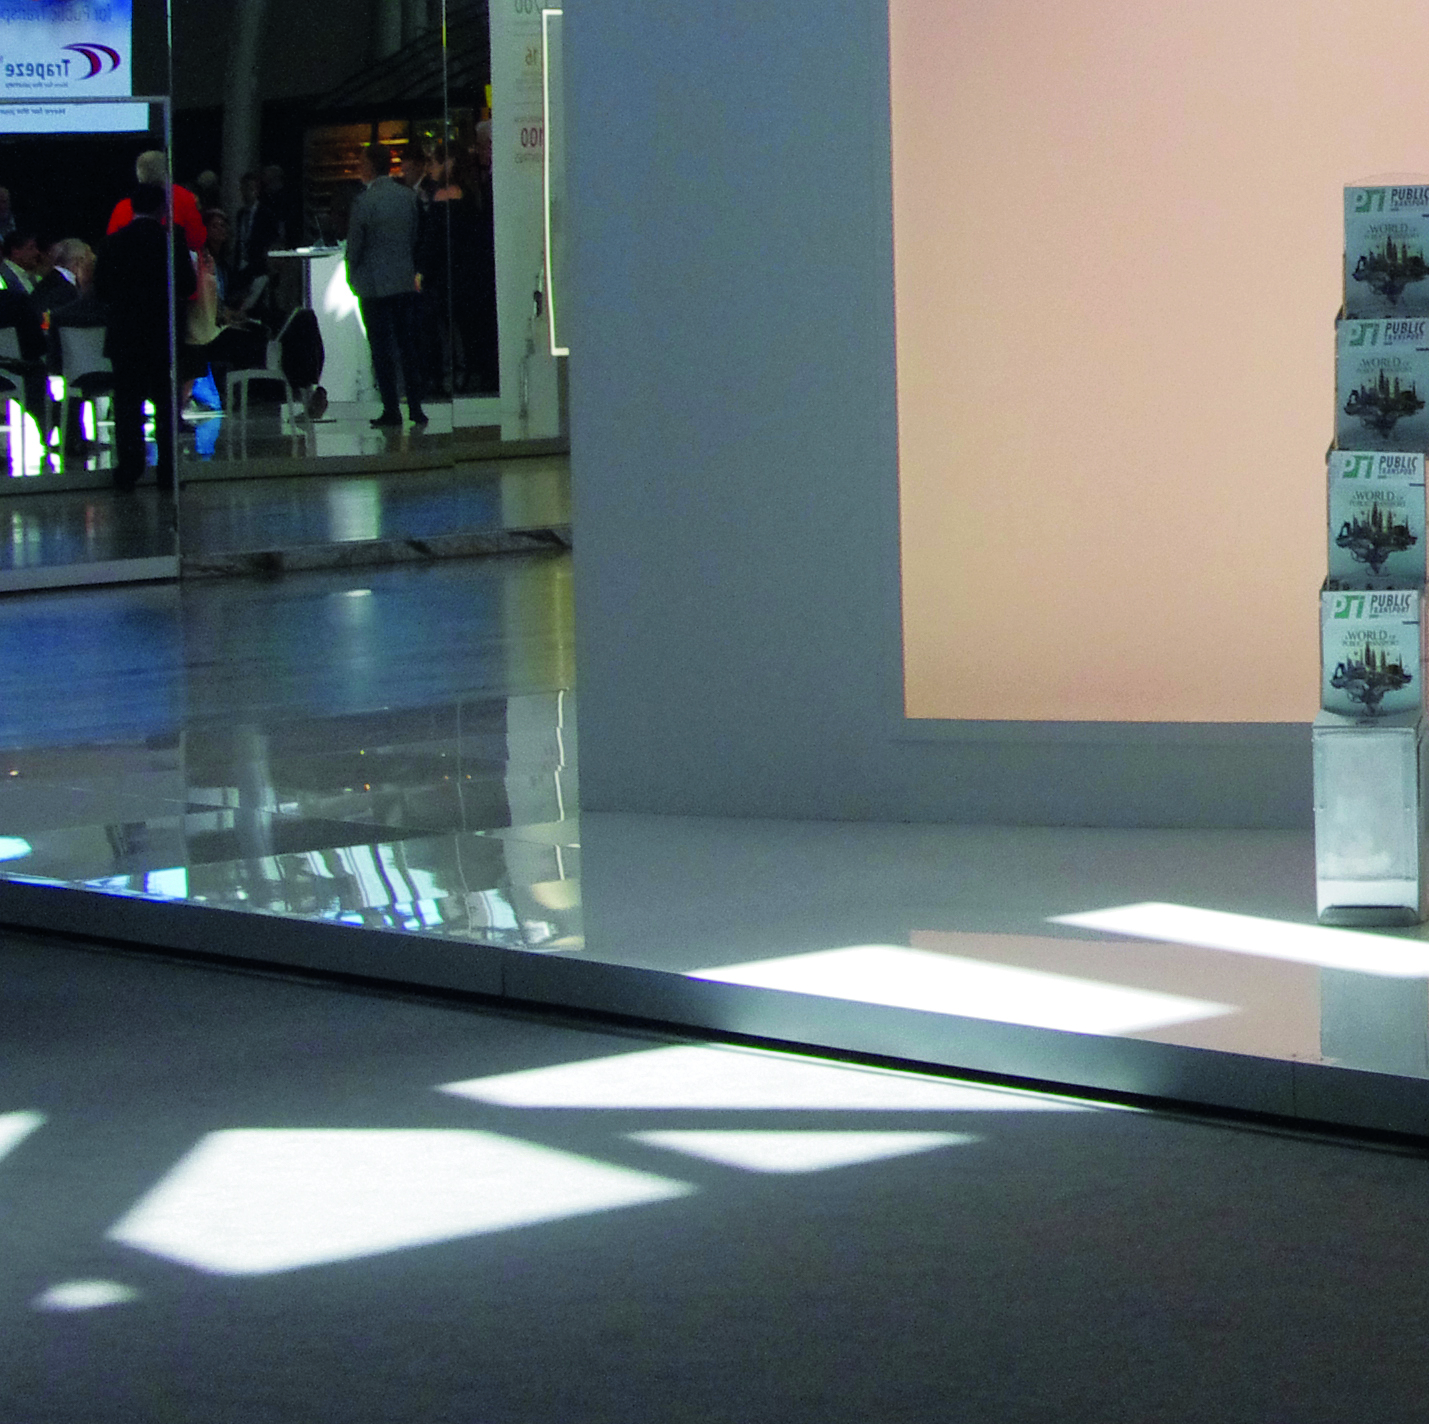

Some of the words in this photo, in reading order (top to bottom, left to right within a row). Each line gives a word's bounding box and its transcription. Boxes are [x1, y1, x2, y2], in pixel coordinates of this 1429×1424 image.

[1390, 187, 1429, 201] PUBLIC
[1384, 321, 1426, 336] PUBLIC
[1379, 455, 1418, 470] PUBLIC
[1370, 594, 1412, 607] PUBLIC
